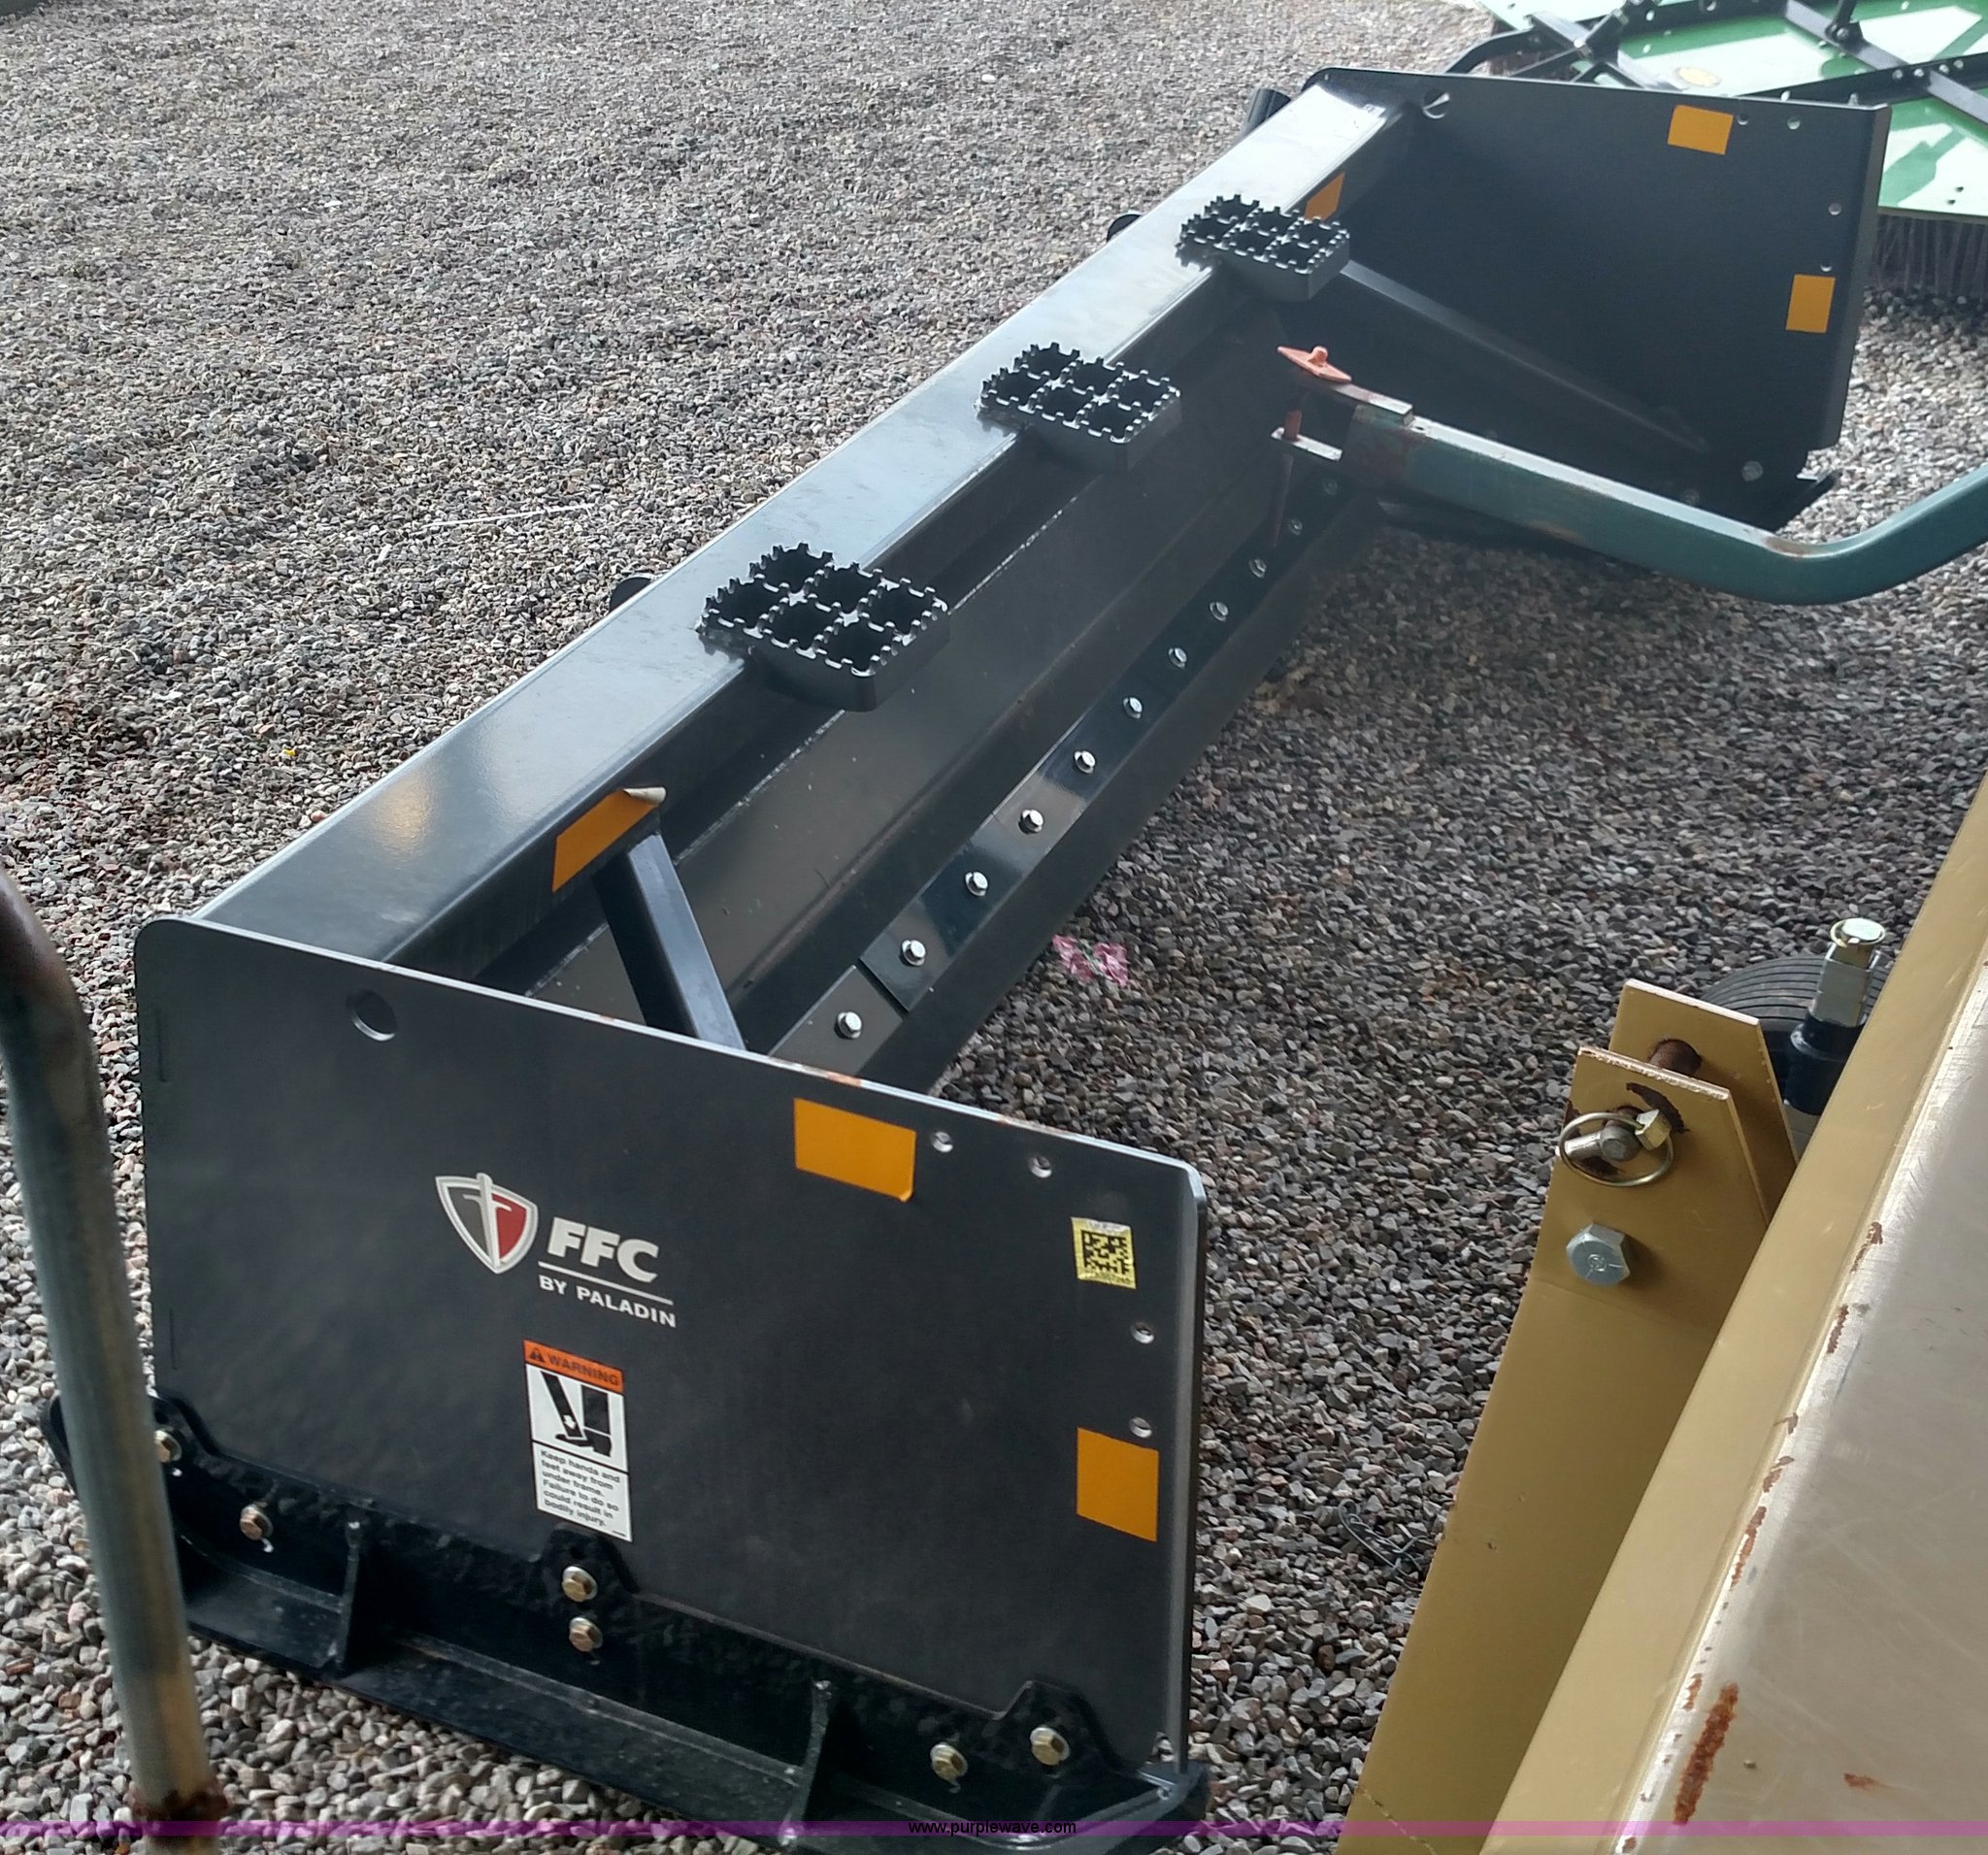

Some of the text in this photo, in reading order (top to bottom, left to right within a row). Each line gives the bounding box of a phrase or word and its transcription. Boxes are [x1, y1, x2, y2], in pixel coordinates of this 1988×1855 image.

[547, 1217, 659, 1283] FFC
[539, 1275, 677, 1328] BY PALADIN
[548, 1354, 618, 1386] WARNING
[541, 1449, 620, 1483] Keep hands and
[542, 1459, 613, 1490] feet away from
[543, 1471, 570, 1484] under
[544, 1479, 618, 1511] Failure to do so
[544, 1490, 571, 1504] could
[574, 1499, 601, 1514] result
